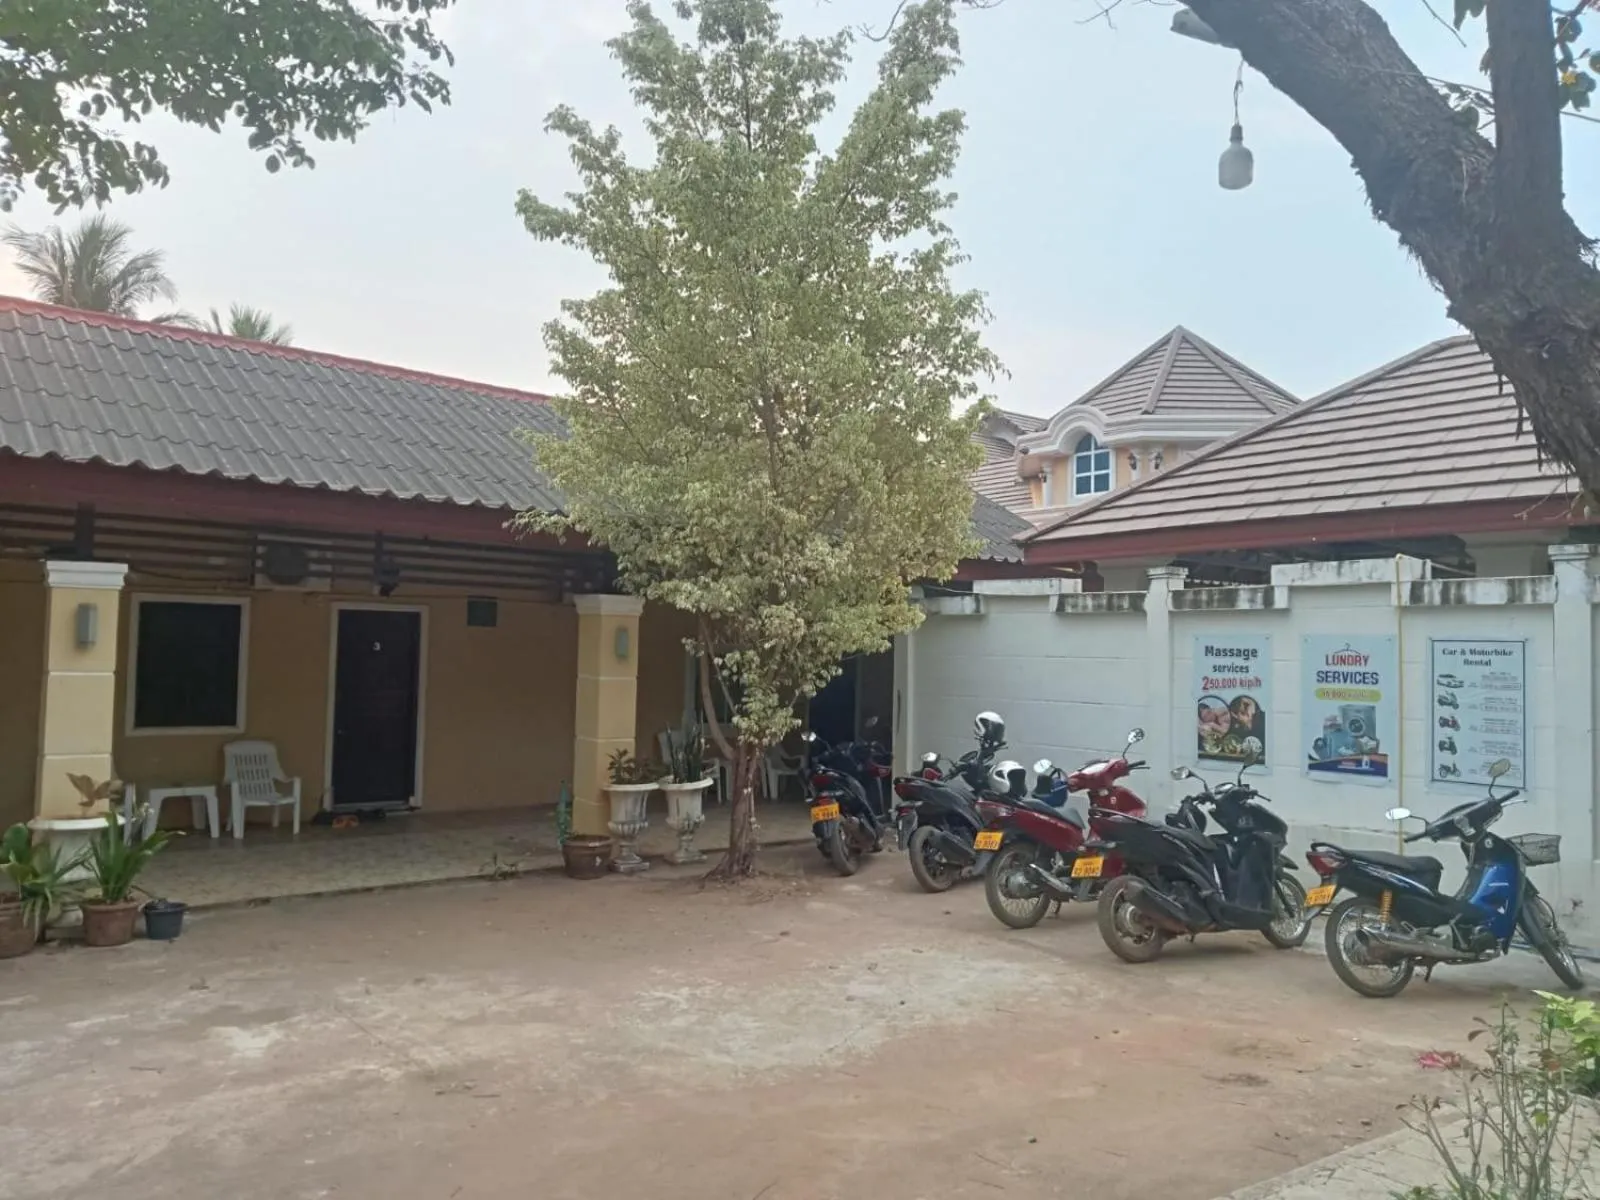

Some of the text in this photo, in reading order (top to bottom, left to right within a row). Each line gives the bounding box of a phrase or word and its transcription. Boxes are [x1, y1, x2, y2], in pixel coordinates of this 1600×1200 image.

[372, 641, 381, 651] 3
[1204, 645, 1258, 661] Massage
[1442, 648, 1514, 657] Car & Motorbike
[1325, 654, 1370, 667] LUNDRY
[1463, 659, 1492, 667] Rental
[1212, 662, 1250, 673] services
[1316, 670, 1380, 685] SERVICES
